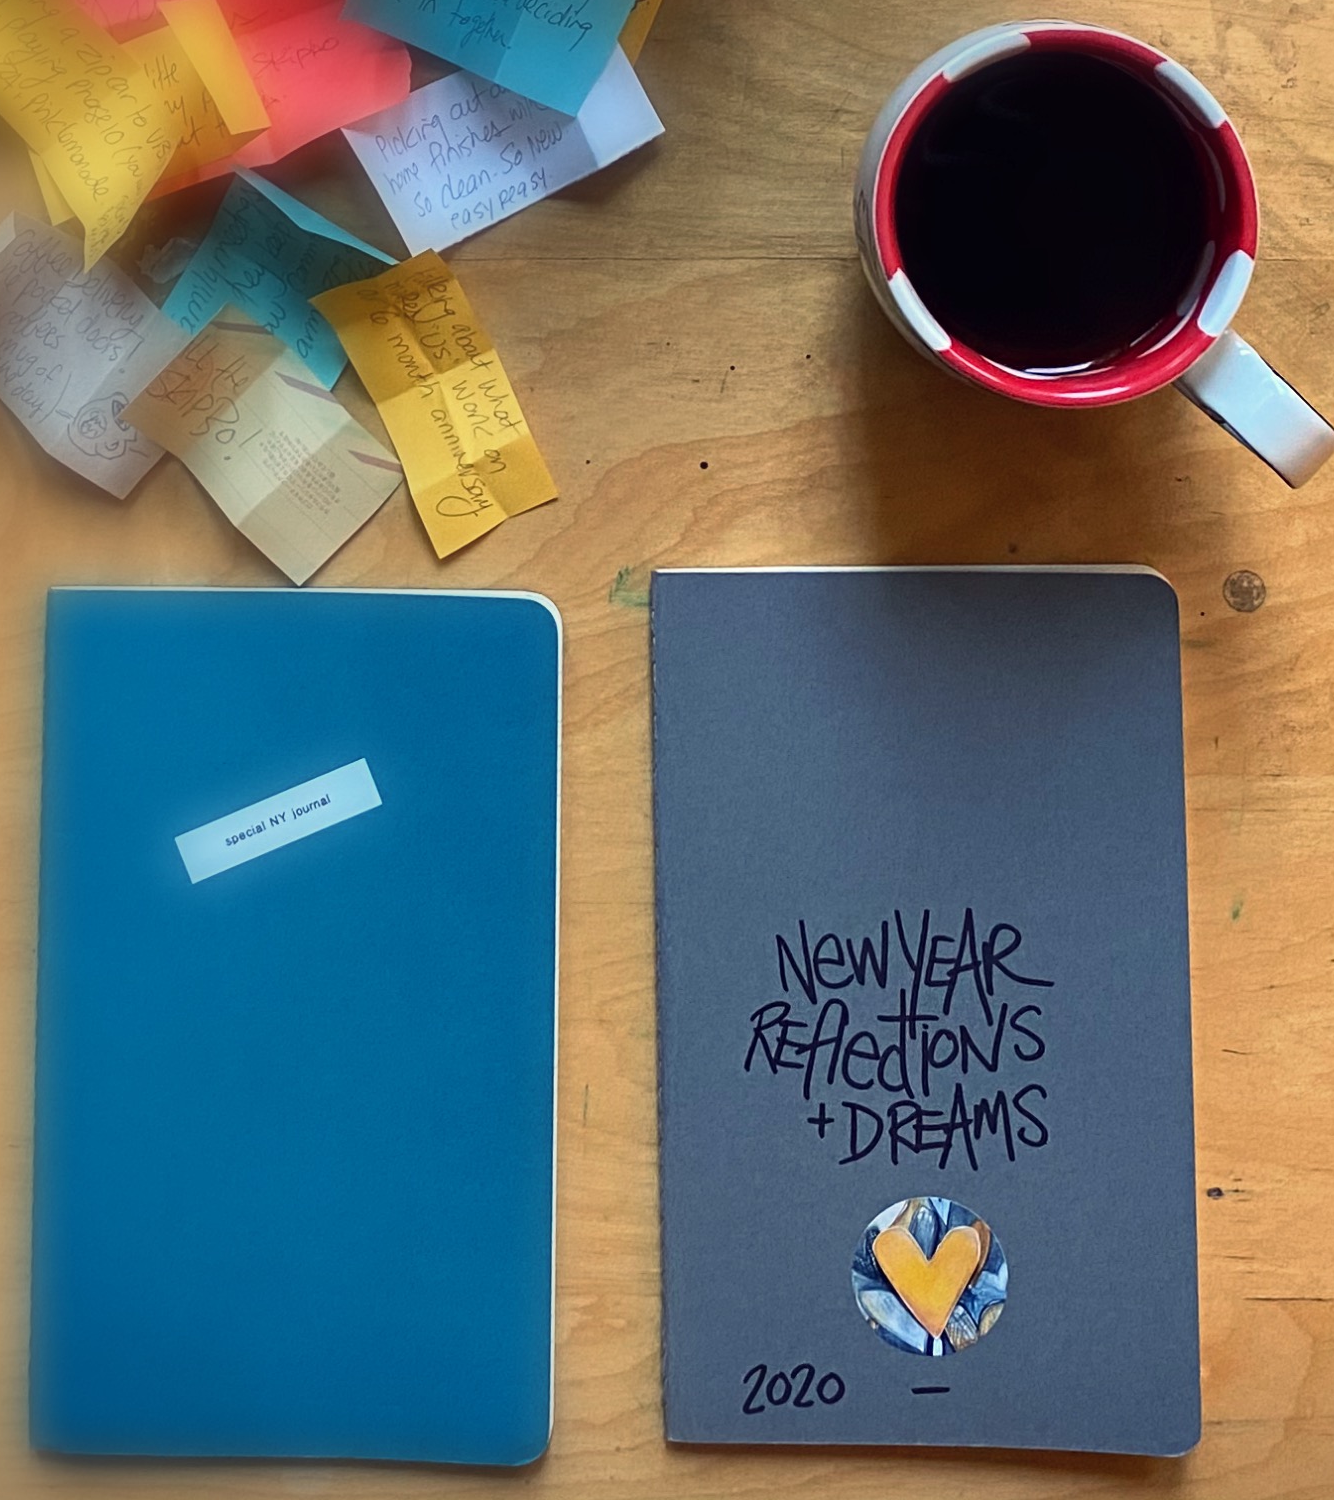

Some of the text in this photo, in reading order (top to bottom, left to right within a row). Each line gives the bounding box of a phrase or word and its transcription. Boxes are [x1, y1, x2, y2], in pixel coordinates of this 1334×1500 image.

[387, 332, 436, 399] month
[225, 793, 332, 847] special NY journal
[741, 1362, 846, 1415] 2020
